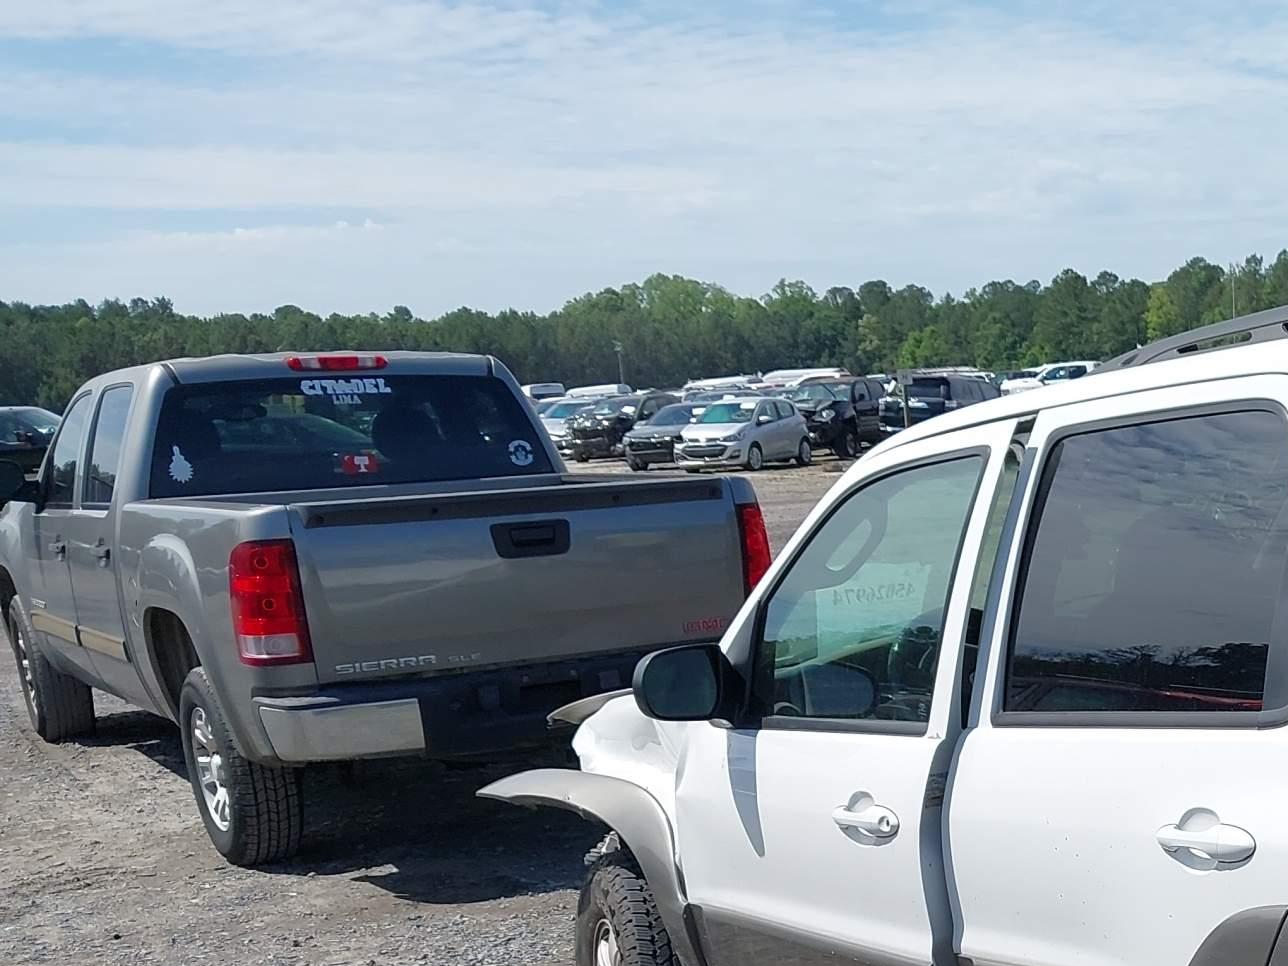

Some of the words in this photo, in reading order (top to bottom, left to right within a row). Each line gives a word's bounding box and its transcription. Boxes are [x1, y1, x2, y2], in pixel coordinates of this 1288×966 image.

[301, 378, 392, 395] CITADEL
[332, 394, 362, 405] LIMA
[335, 655, 437, 675] SIERRA
